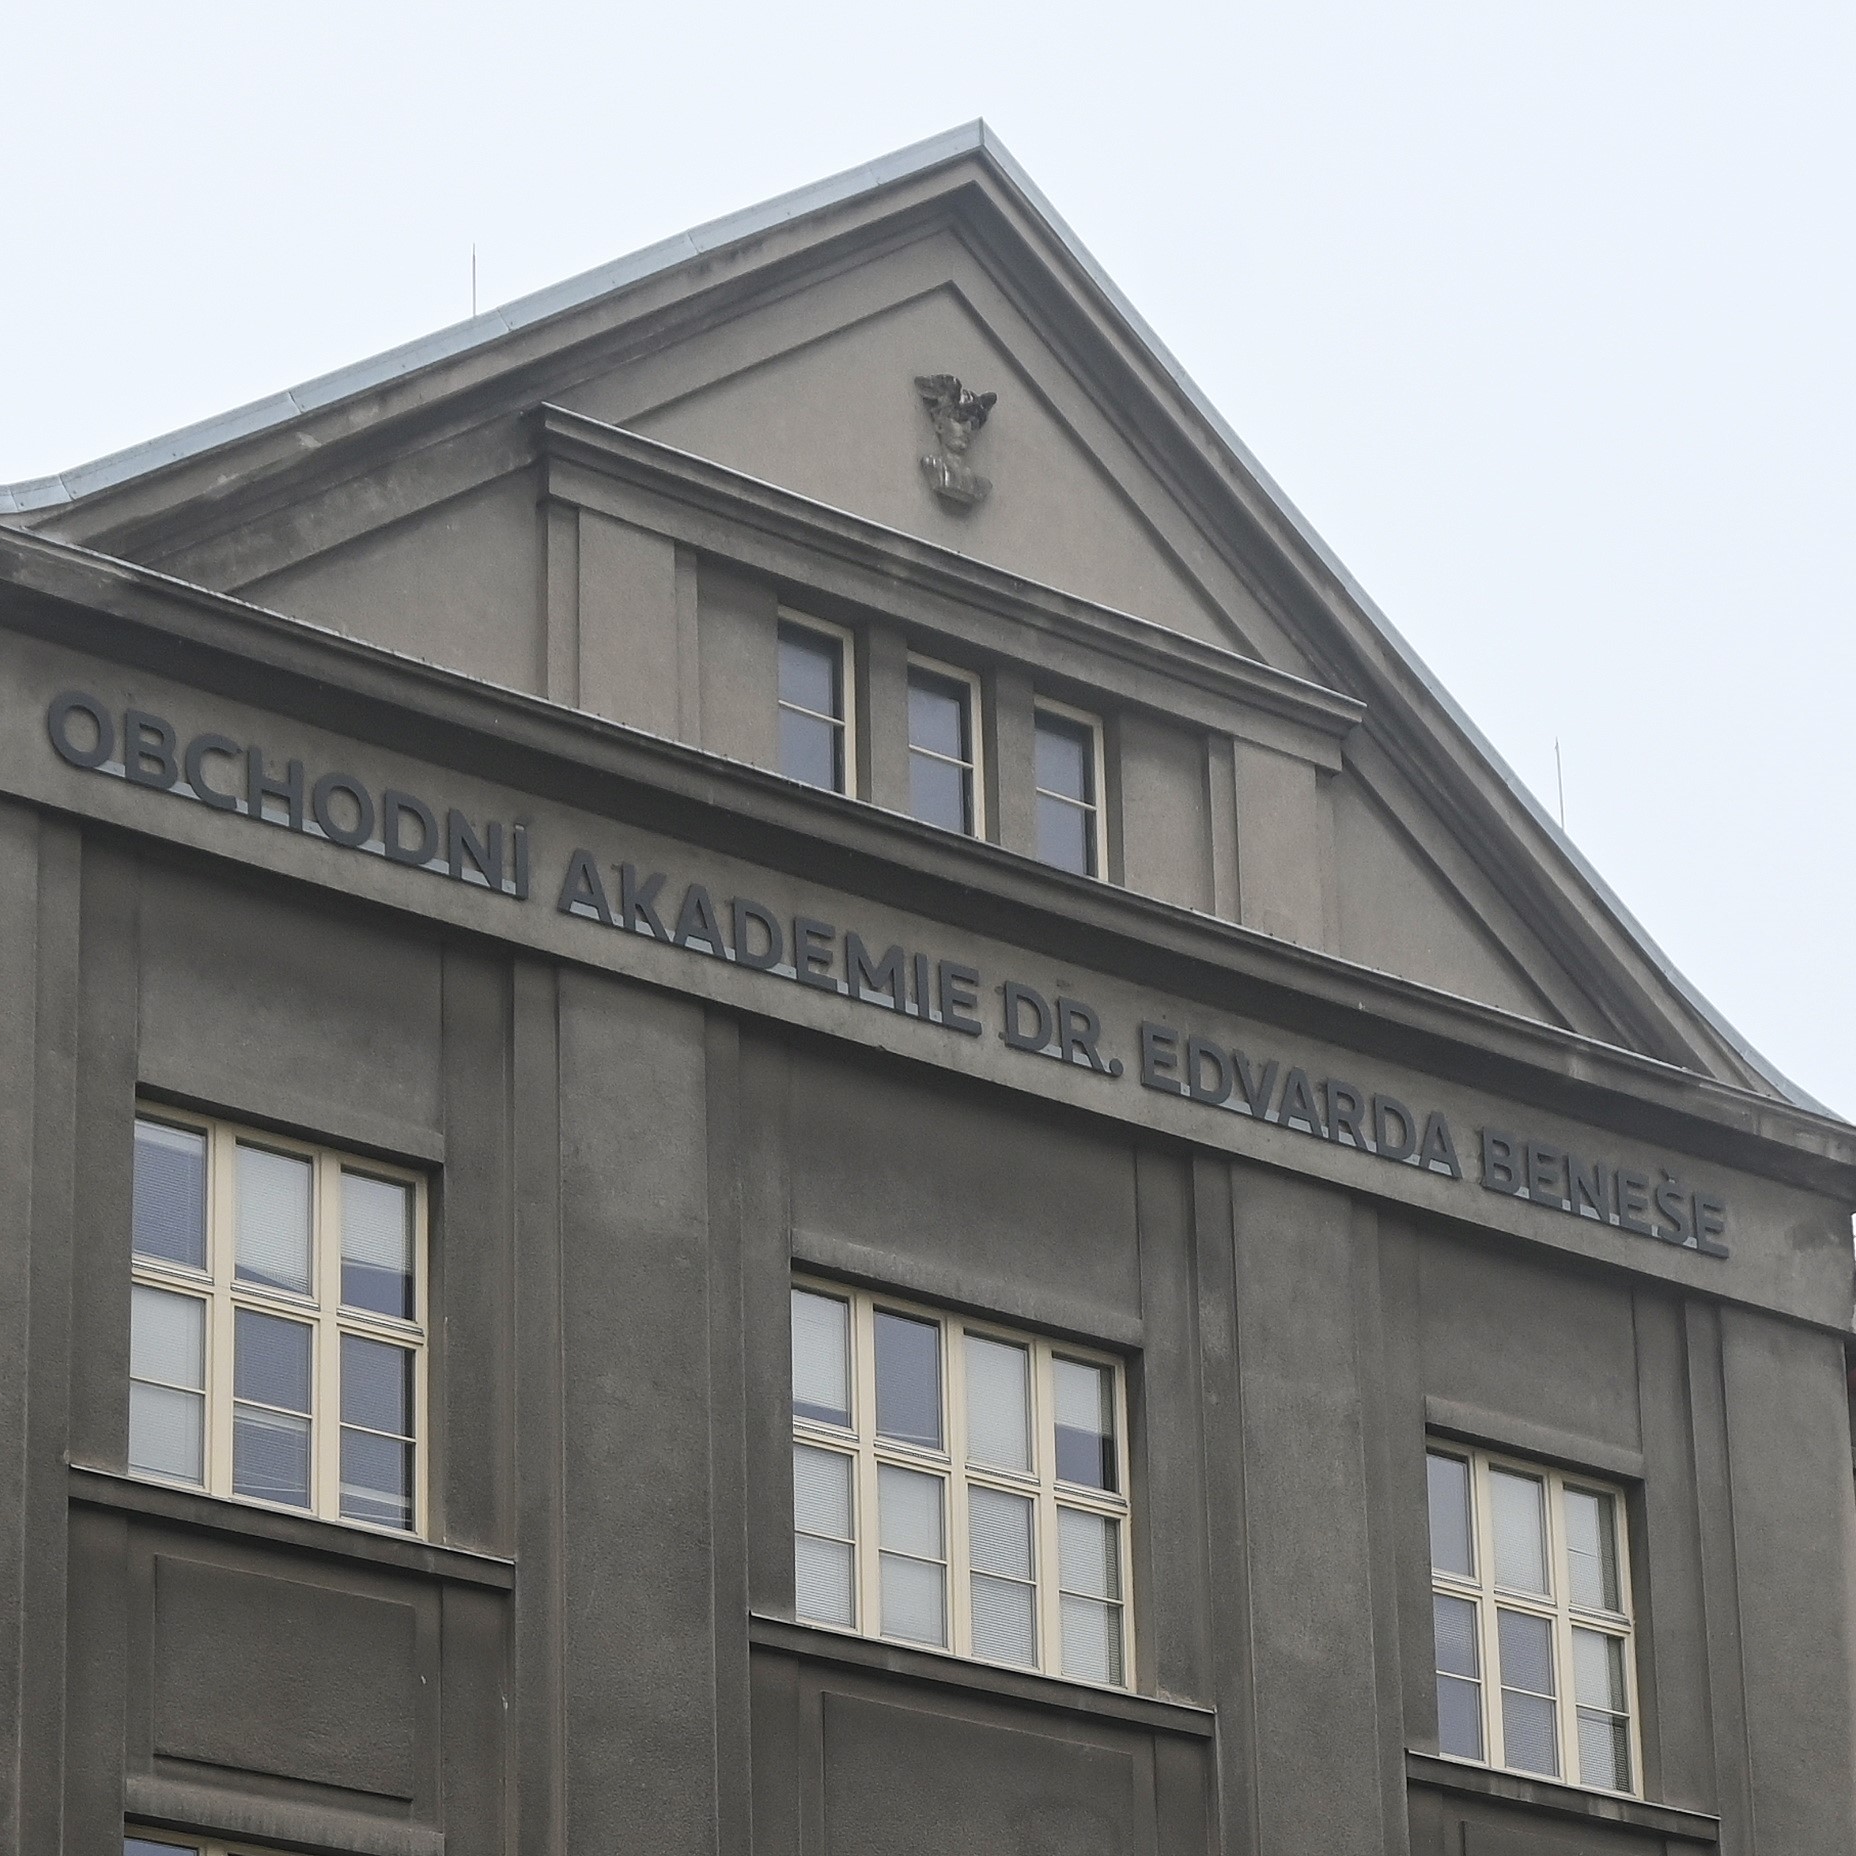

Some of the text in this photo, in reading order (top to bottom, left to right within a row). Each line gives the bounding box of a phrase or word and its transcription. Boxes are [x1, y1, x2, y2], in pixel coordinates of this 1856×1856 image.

[47, 691, 1730, 1259] OBCHODNÍ AKADEMIE DR. EDVARDA BENEŠE
